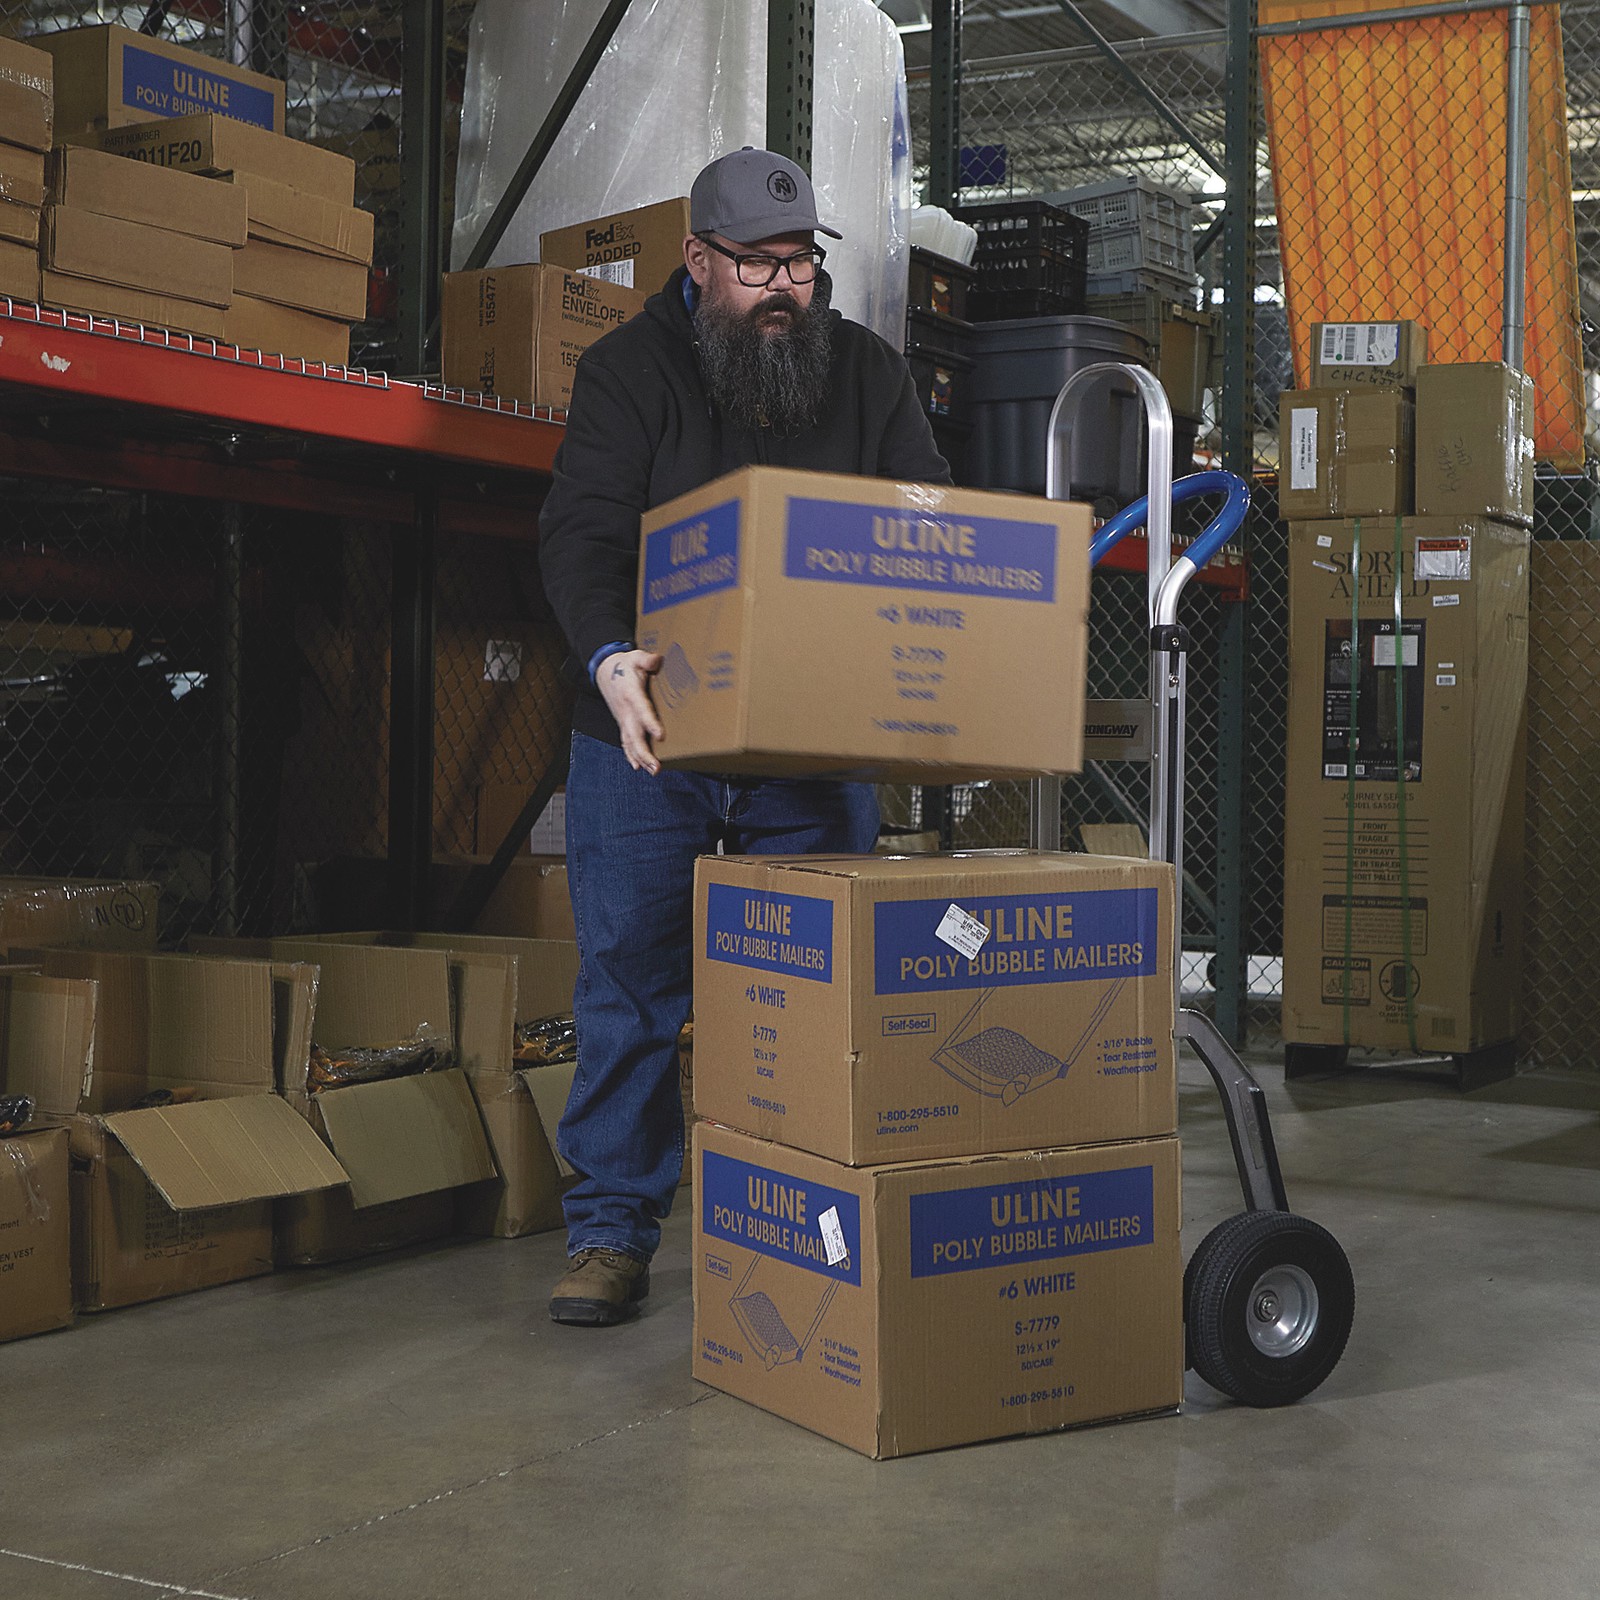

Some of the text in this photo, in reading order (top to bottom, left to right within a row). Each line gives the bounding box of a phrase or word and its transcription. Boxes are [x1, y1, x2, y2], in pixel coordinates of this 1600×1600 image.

[136, 85, 169, 109] POLY
[173, 69, 230, 108] ULINE
[104, 130, 160, 148] PART NUMBER
[586, 221, 635, 250] FedEx
[586, 241, 641, 267] PADDED
[485, 276, 497, 326] 155477
[562, 295, 625, 325] ENVELOPE
[561, 312, 584, 328] (without
[560, 351, 578, 368] 155
[872, 514, 977, 558] ULINE
[805, 545, 1044, 593] POLY BUBBLE MAILERS
[1362, 822, 1388, 831] FRONT
[1369, 848, 1395, 856] HEAVY
[744, 898, 791, 936] ULINE
[716, 930, 825, 971] POLY BUBBLE MAILERS
[900, 942, 1144, 981] POLY BUBBLE MAILERS
[1324, 959, 1369, 968] CAUION
[745, 984, 786, 1010] #6 WHITE
[752, 1024, 777, 1044] S-7779
[888, 1018, 931, 1031] Self-Seal
[1125, 1036, 1153, 1047] Bubble
[1103, 1049, 1157, 1063] Tear Resistant
[1103, 1062, 1158, 1077] Weatherproof
[876, 1104, 960, 1123] 1-800-295-5510
[876, 1122, 919, 1136] uline.com
[747, 1176, 807, 1226] ULINE
[991, 1186, 1081, 1228] ULINE
[713, 1204, 744, 1234] POLY
[747, 1217, 790, 1251] BUBBLE
[933, 1215, 1141, 1264] POLY BUBBLE MAILERS
[14, 1246, 34, 1260] VEST
[999, 1271, 1076, 1300] #6 WHITE
[1015, 1315, 1060, 1337] S-7779
[1021, 1356, 1055, 1371] 50/CASE
[1000, 1385, 1075, 1408] 1-800-295-5510
